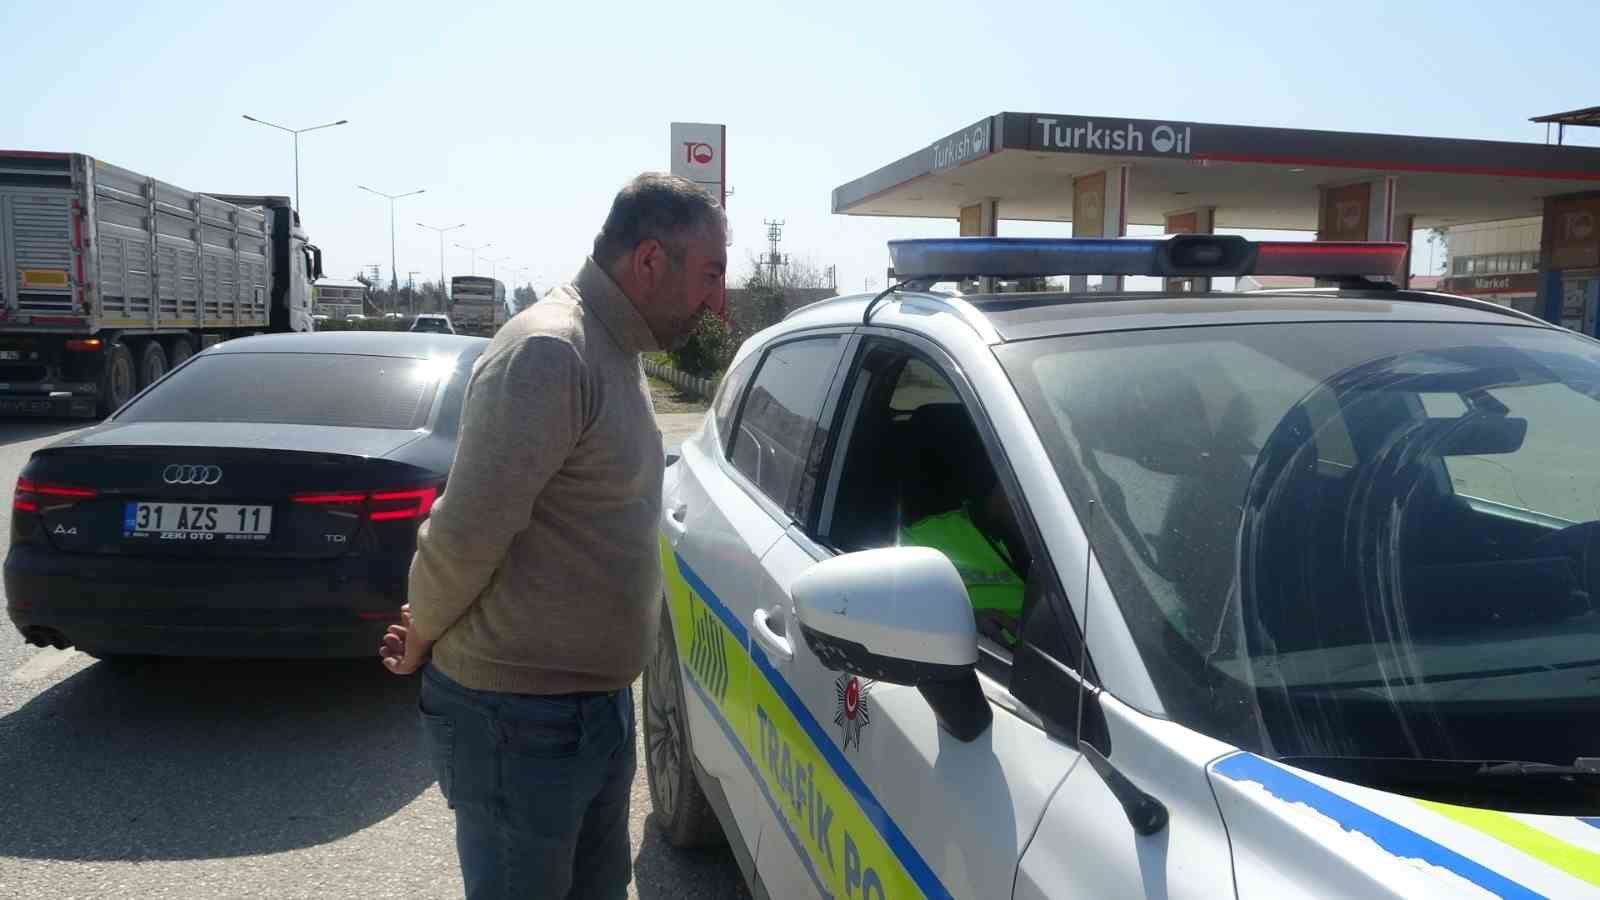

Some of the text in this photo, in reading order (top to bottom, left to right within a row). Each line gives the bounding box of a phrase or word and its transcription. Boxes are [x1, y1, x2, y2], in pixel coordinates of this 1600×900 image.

[1036, 118, 1190, 153] Turkish Oil
[934, 133, 969, 168] Turkish
[1475, 278, 1509, 289] Market
[138, 505, 260, 531] 31 AZS 11
[53, 523, 77, 535] A4
[190, 532, 214, 540] OTO
[324, 534, 346, 543] TDI
